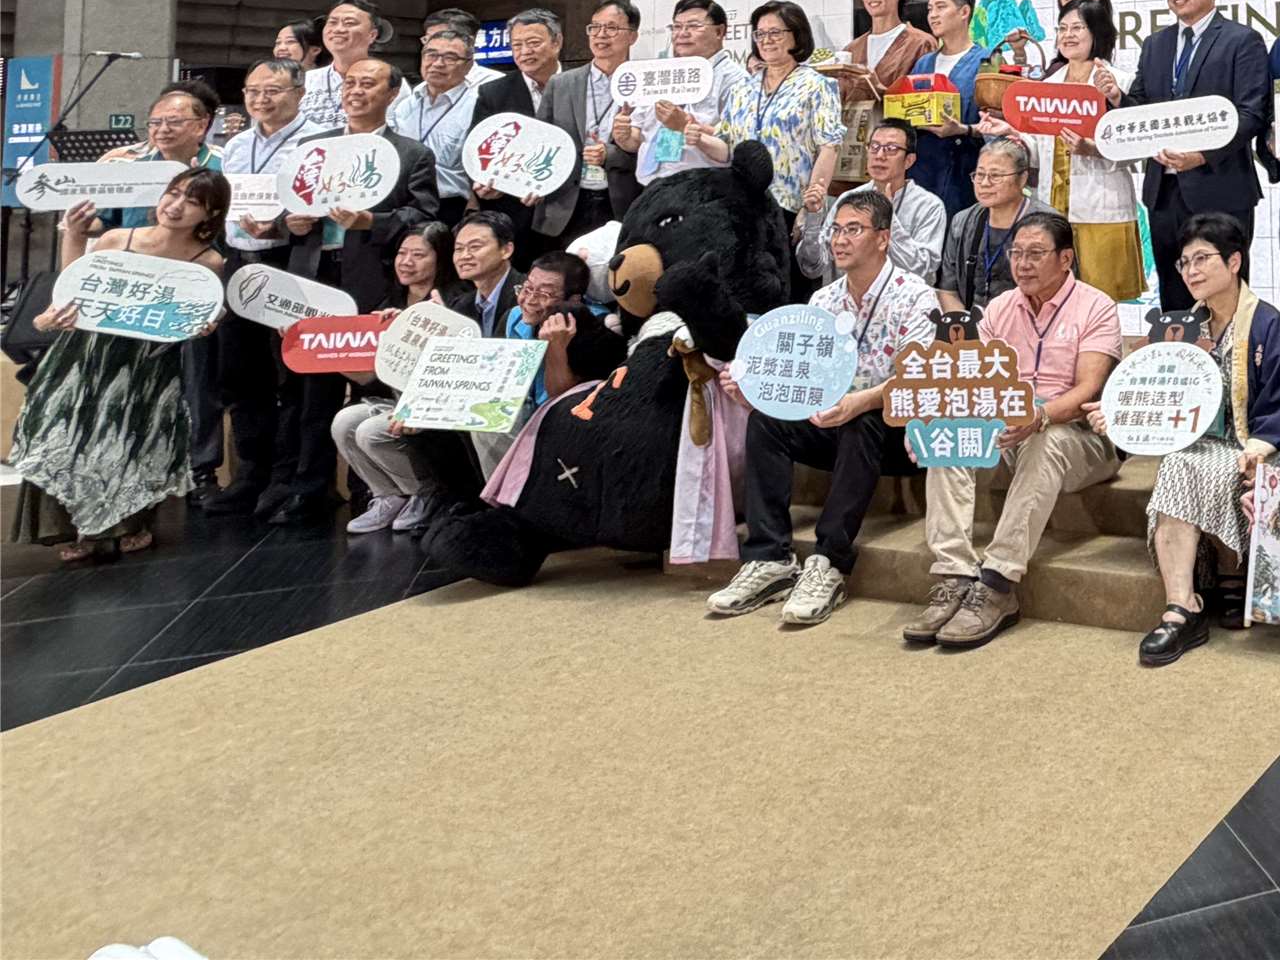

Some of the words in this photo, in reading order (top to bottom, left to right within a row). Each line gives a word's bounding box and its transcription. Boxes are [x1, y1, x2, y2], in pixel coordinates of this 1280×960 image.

[642, 68, 701, 87] 臺灣鐵路
[1015, 95, 1098, 117] TAIWAN
[111, 116, 132, 128] L22
[1115, 109, 1230, 135] 中華民國溫泉觀光協會
[80, 273, 175, 304] 台灣好湯
[71, 296, 167, 330] 天天好日
[265, 293, 337, 318] 交通部觀
[754, 310, 825, 338] Guanziling
[299, 330, 377, 349] TAIWA
[776, 331, 835, 359] 關子嶺
[423, 365, 449, 375] FROM
[429, 353, 479, 364] GREETINGS
[746, 355, 811, 380] 泥漿溫泉
[901, 349, 1011, 379] 全台最大
[418, 378, 451, 389] TAIWAN
[452, 380, 492, 391] SPRINGS
[758, 381, 825, 407] 泡泡面膜
[889, 386, 1027, 418] 熊愛泡湯在
[1118, 390, 1184, 407] 喔熊造型
[1112, 410, 1163, 426] 雞蛋糕
[1168, 405, 1201, 433] +1
